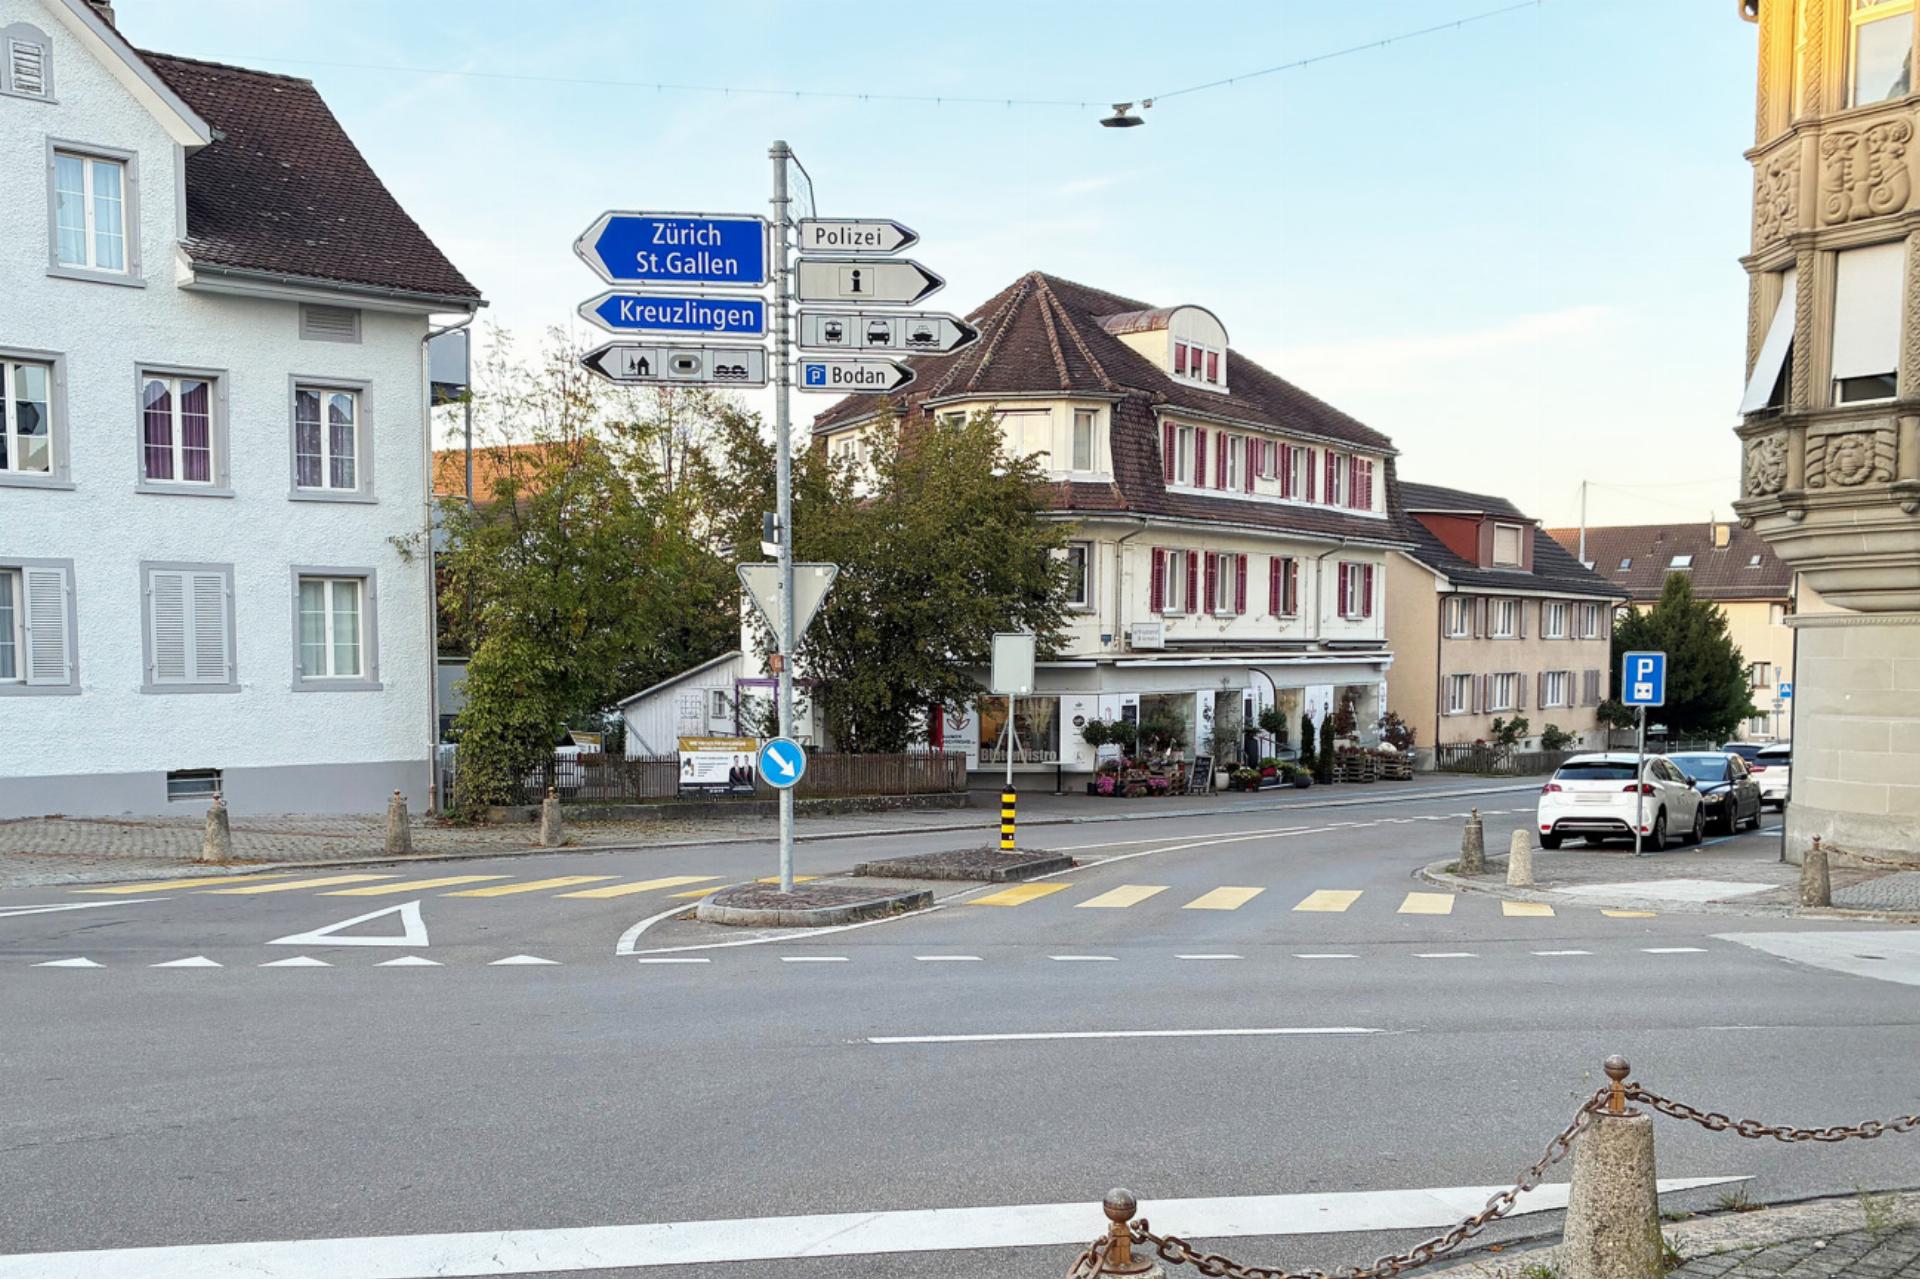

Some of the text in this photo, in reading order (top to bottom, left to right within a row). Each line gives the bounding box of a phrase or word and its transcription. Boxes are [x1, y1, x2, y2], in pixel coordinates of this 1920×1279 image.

[652, 222, 721, 246] Zürich
[815, 226, 881, 246] Polizei
[636, 251, 738, 275] St.Gallen
[620, 300, 755, 331] Kreuzlingen
[832, 366, 886, 384] Bodan
[1637, 658, 1654, 682] P
